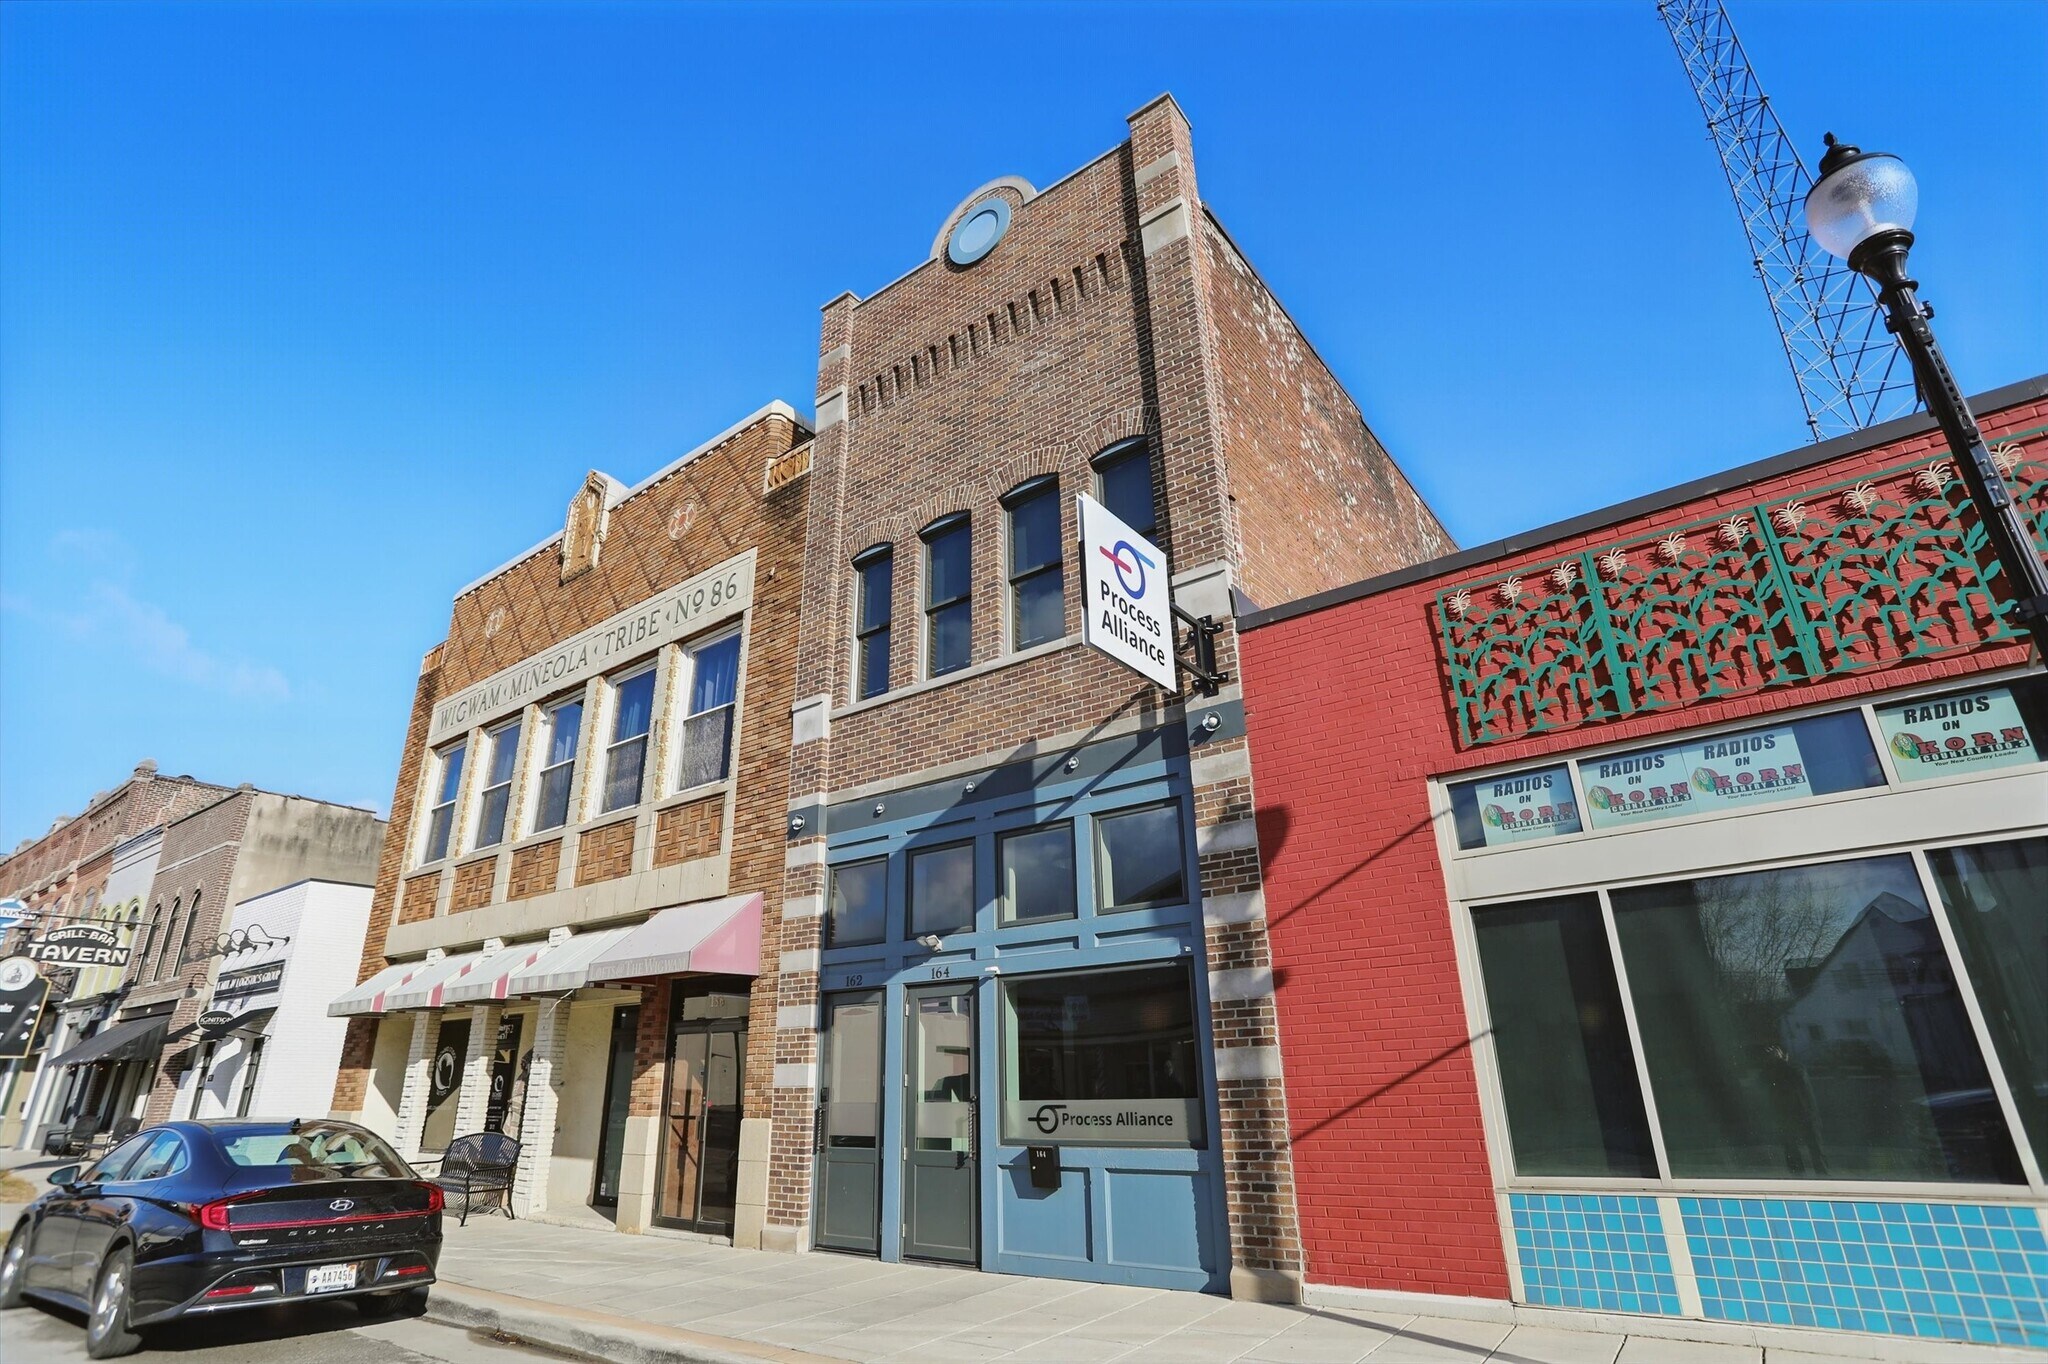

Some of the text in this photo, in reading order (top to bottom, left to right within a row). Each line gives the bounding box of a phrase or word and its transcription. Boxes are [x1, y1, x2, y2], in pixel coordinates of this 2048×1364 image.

[1100, 579, 1161, 637] Process
[1101, 609, 1165, 666] Alliance
[439, 688, 501, 731] WIGWAM
[508, 644, 588, 699] MINEOLA
[604, 608, 661, 656] TRIBE
[711, 572, 738, 607] 86
[1904, 696, 1990, 724] RADIOS
[1942, 720, 1960, 731] ON
[1704, 734, 1775, 760] RADIOS
[1917, 726, 2026, 754] KORN
[1922, 741, 2028, 762] COUNTRY 100.3
[1995, 750, 2018, 758] Leader
[1600, 754, 1664, 778] RADIOS
[1735, 757, 1750, 766] ON
[1628, 775, 1642, 785] ON
[1713, 764, 1802, 788] KORN
[1494, 775, 1553, 797] RADIOS
[1608, 782, 1688, 806] KORN
[1717, 777, 1805, 795] COUNTRY 100.3
[1519, 795, 1531, 803] ON
[1611, 794, 1691, 813] COUNTRY 100.3
[1500, 802, 1573, 823] KORN
[1503, 813, 1575, 830] COUNTRY 100.3
[27, 943, 128, 964] TAVERN
[262, 970, 281, 982] GROUP
[845, 974, 863, 987] 162
[930, 966, 950, 979] 164
[1062, 1112, 1173, 1126] Process Alliance
[288, 1224, 384, 1236] SONATA
[322, 1270, 352, 1283] AA7456
